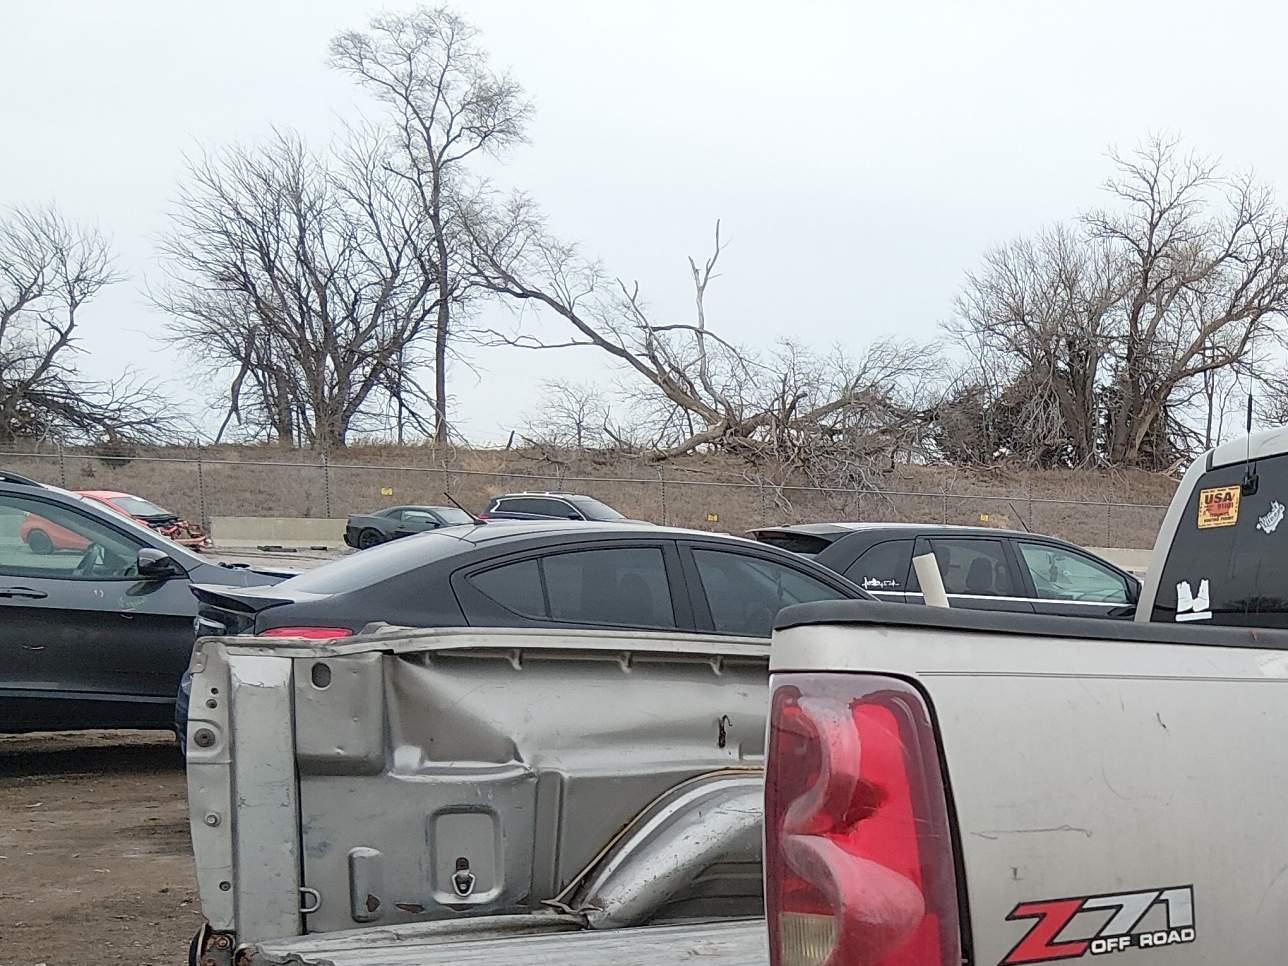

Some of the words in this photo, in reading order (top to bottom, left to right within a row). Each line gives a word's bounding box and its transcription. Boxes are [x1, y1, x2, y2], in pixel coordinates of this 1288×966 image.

[1204, 491, 1233, 505] USA
[1090, 936, 1132, 954] OFF
[1139, 927, 1196, 948] ROAD
